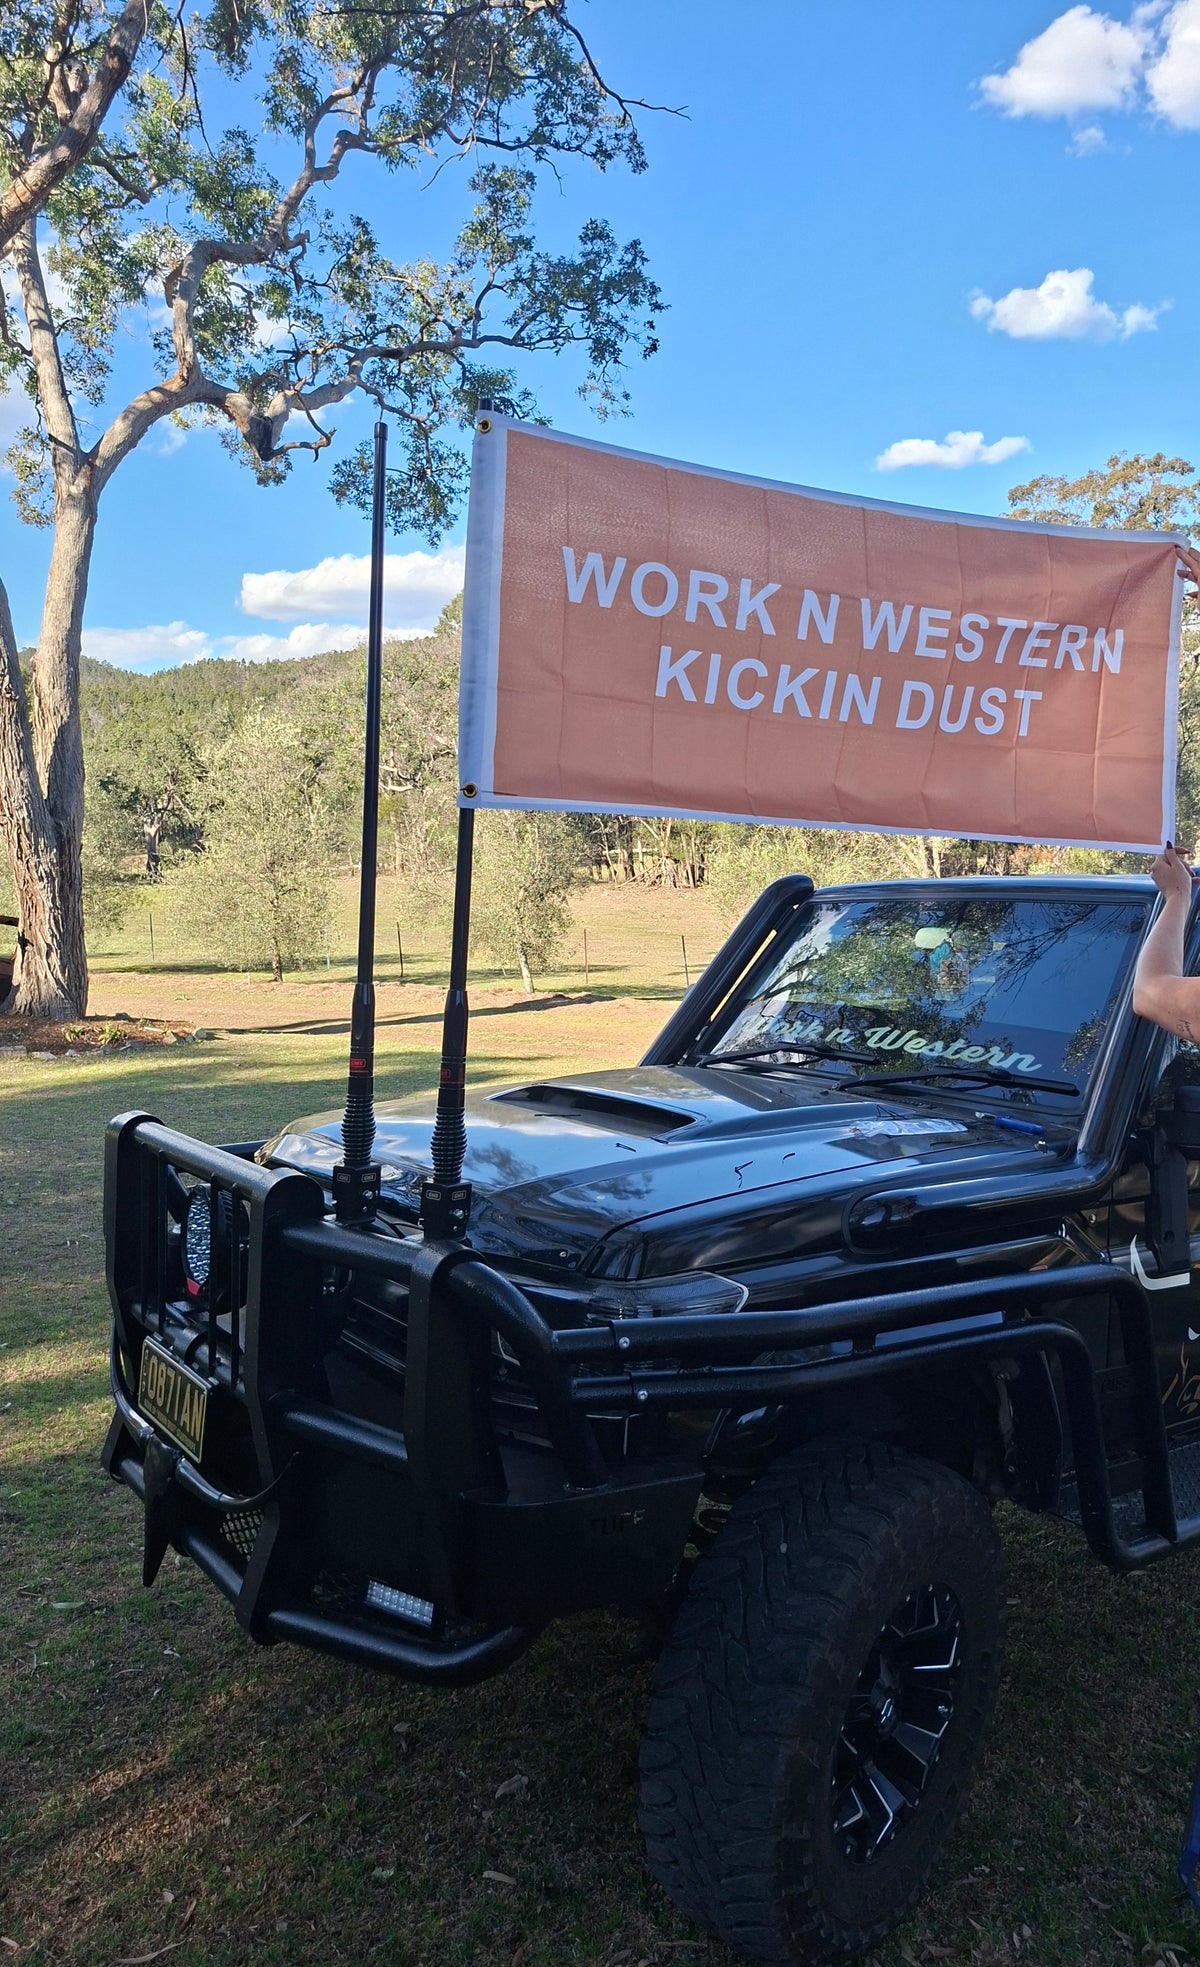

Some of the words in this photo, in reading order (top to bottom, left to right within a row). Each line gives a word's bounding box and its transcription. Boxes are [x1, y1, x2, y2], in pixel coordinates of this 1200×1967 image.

[561, 546, 782, 636] WORK
[796, 589, 841, 645] N
[861, 597, 1126, 674] WESTERN
[655, 645, 882, 726] KICKIN
[896, 680, 1043, 738] DUST
[864, 1026, 1043, 1073] Western
